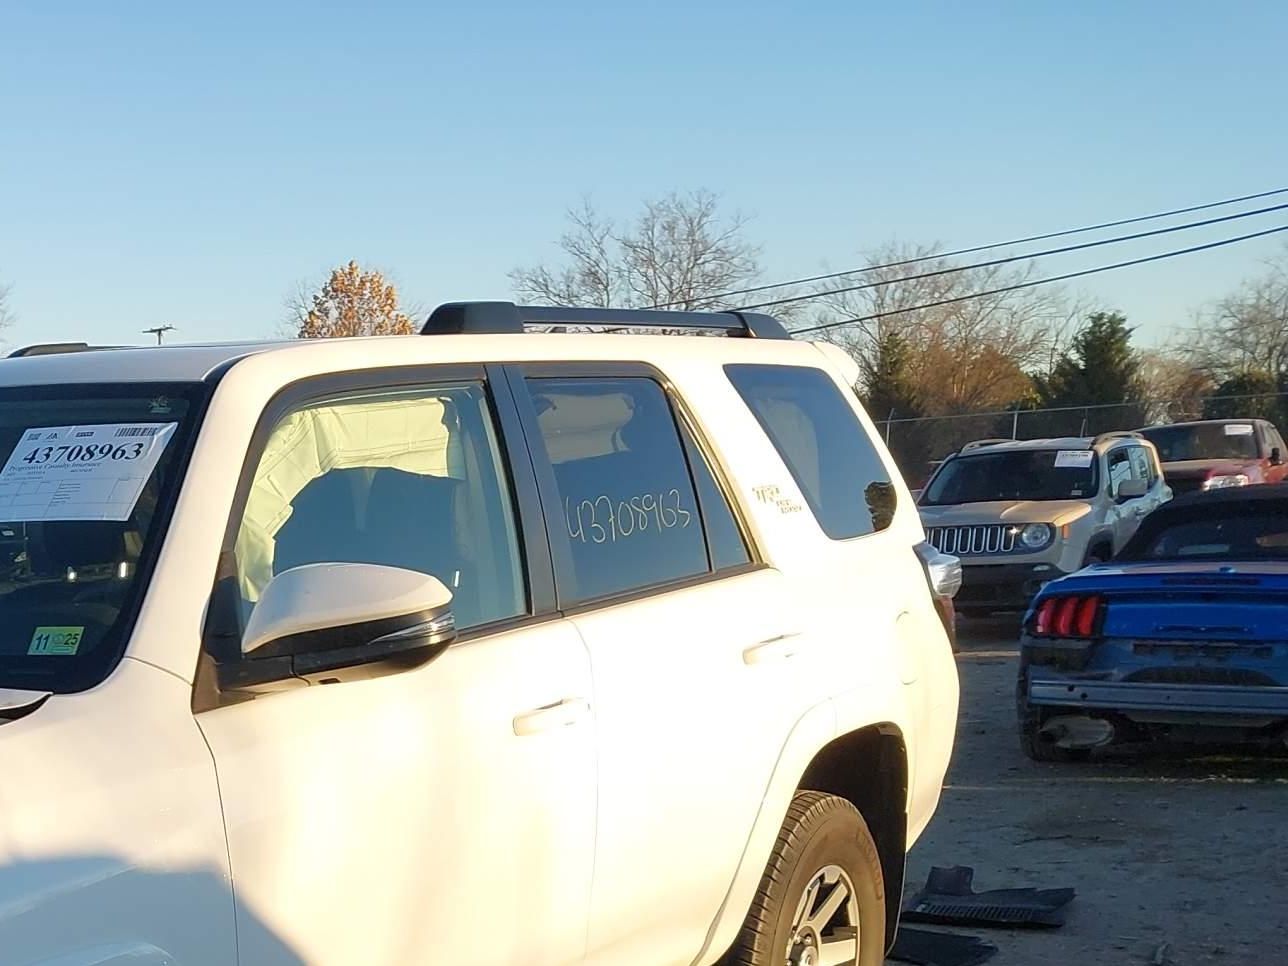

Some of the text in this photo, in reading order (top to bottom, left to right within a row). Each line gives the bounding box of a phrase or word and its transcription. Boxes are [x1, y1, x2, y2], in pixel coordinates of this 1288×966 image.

[23, 442, 144, 464] 43708963
[566, 489, 691, 543] 43708963
[35, 633, 50, 650] 11
[64, 632, 80, 646] 25
